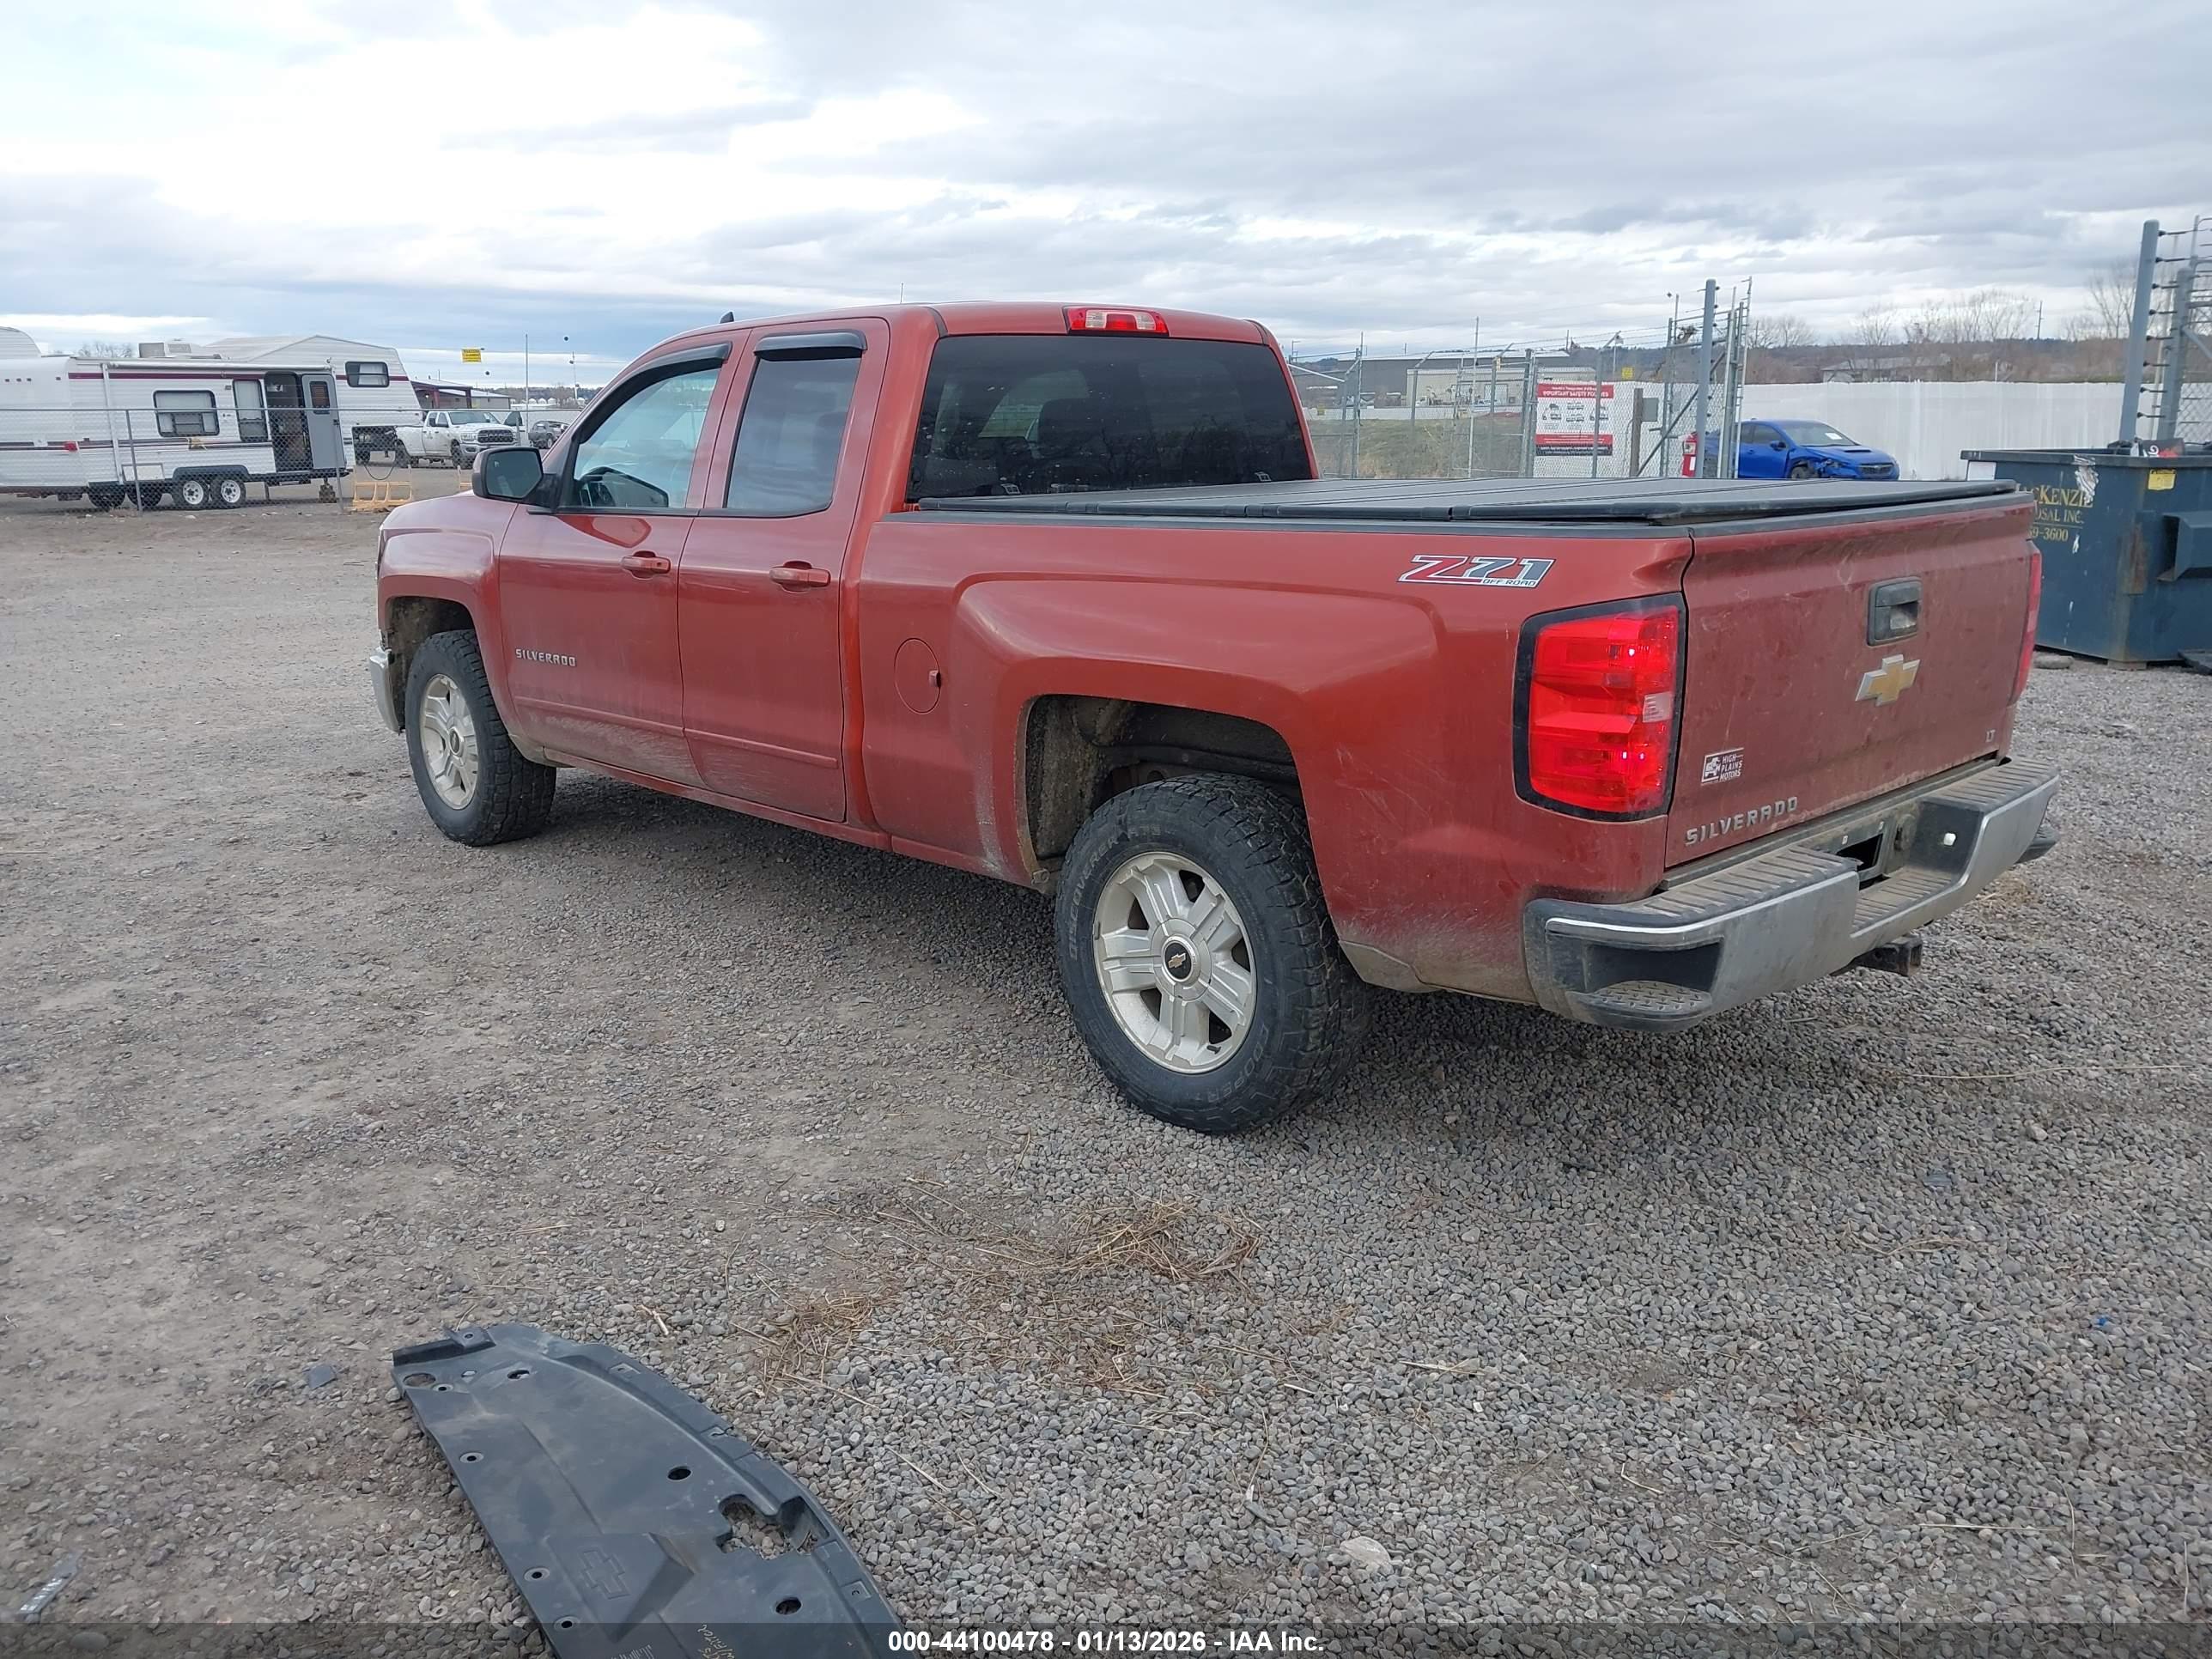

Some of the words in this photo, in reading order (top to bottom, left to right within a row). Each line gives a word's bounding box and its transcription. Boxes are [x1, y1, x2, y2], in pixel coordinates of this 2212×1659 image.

[1397, 555, 1556, 587] Z71
[515, 648, 576, 667] SILVERADO
[1723, 753, 1737, 764] HIGH
[1721, 760, 1743, 774] PLAINS
[1719, 769, 1741, 782] MOTORS
[1685, 797, 1798, 847] SILVERADO
